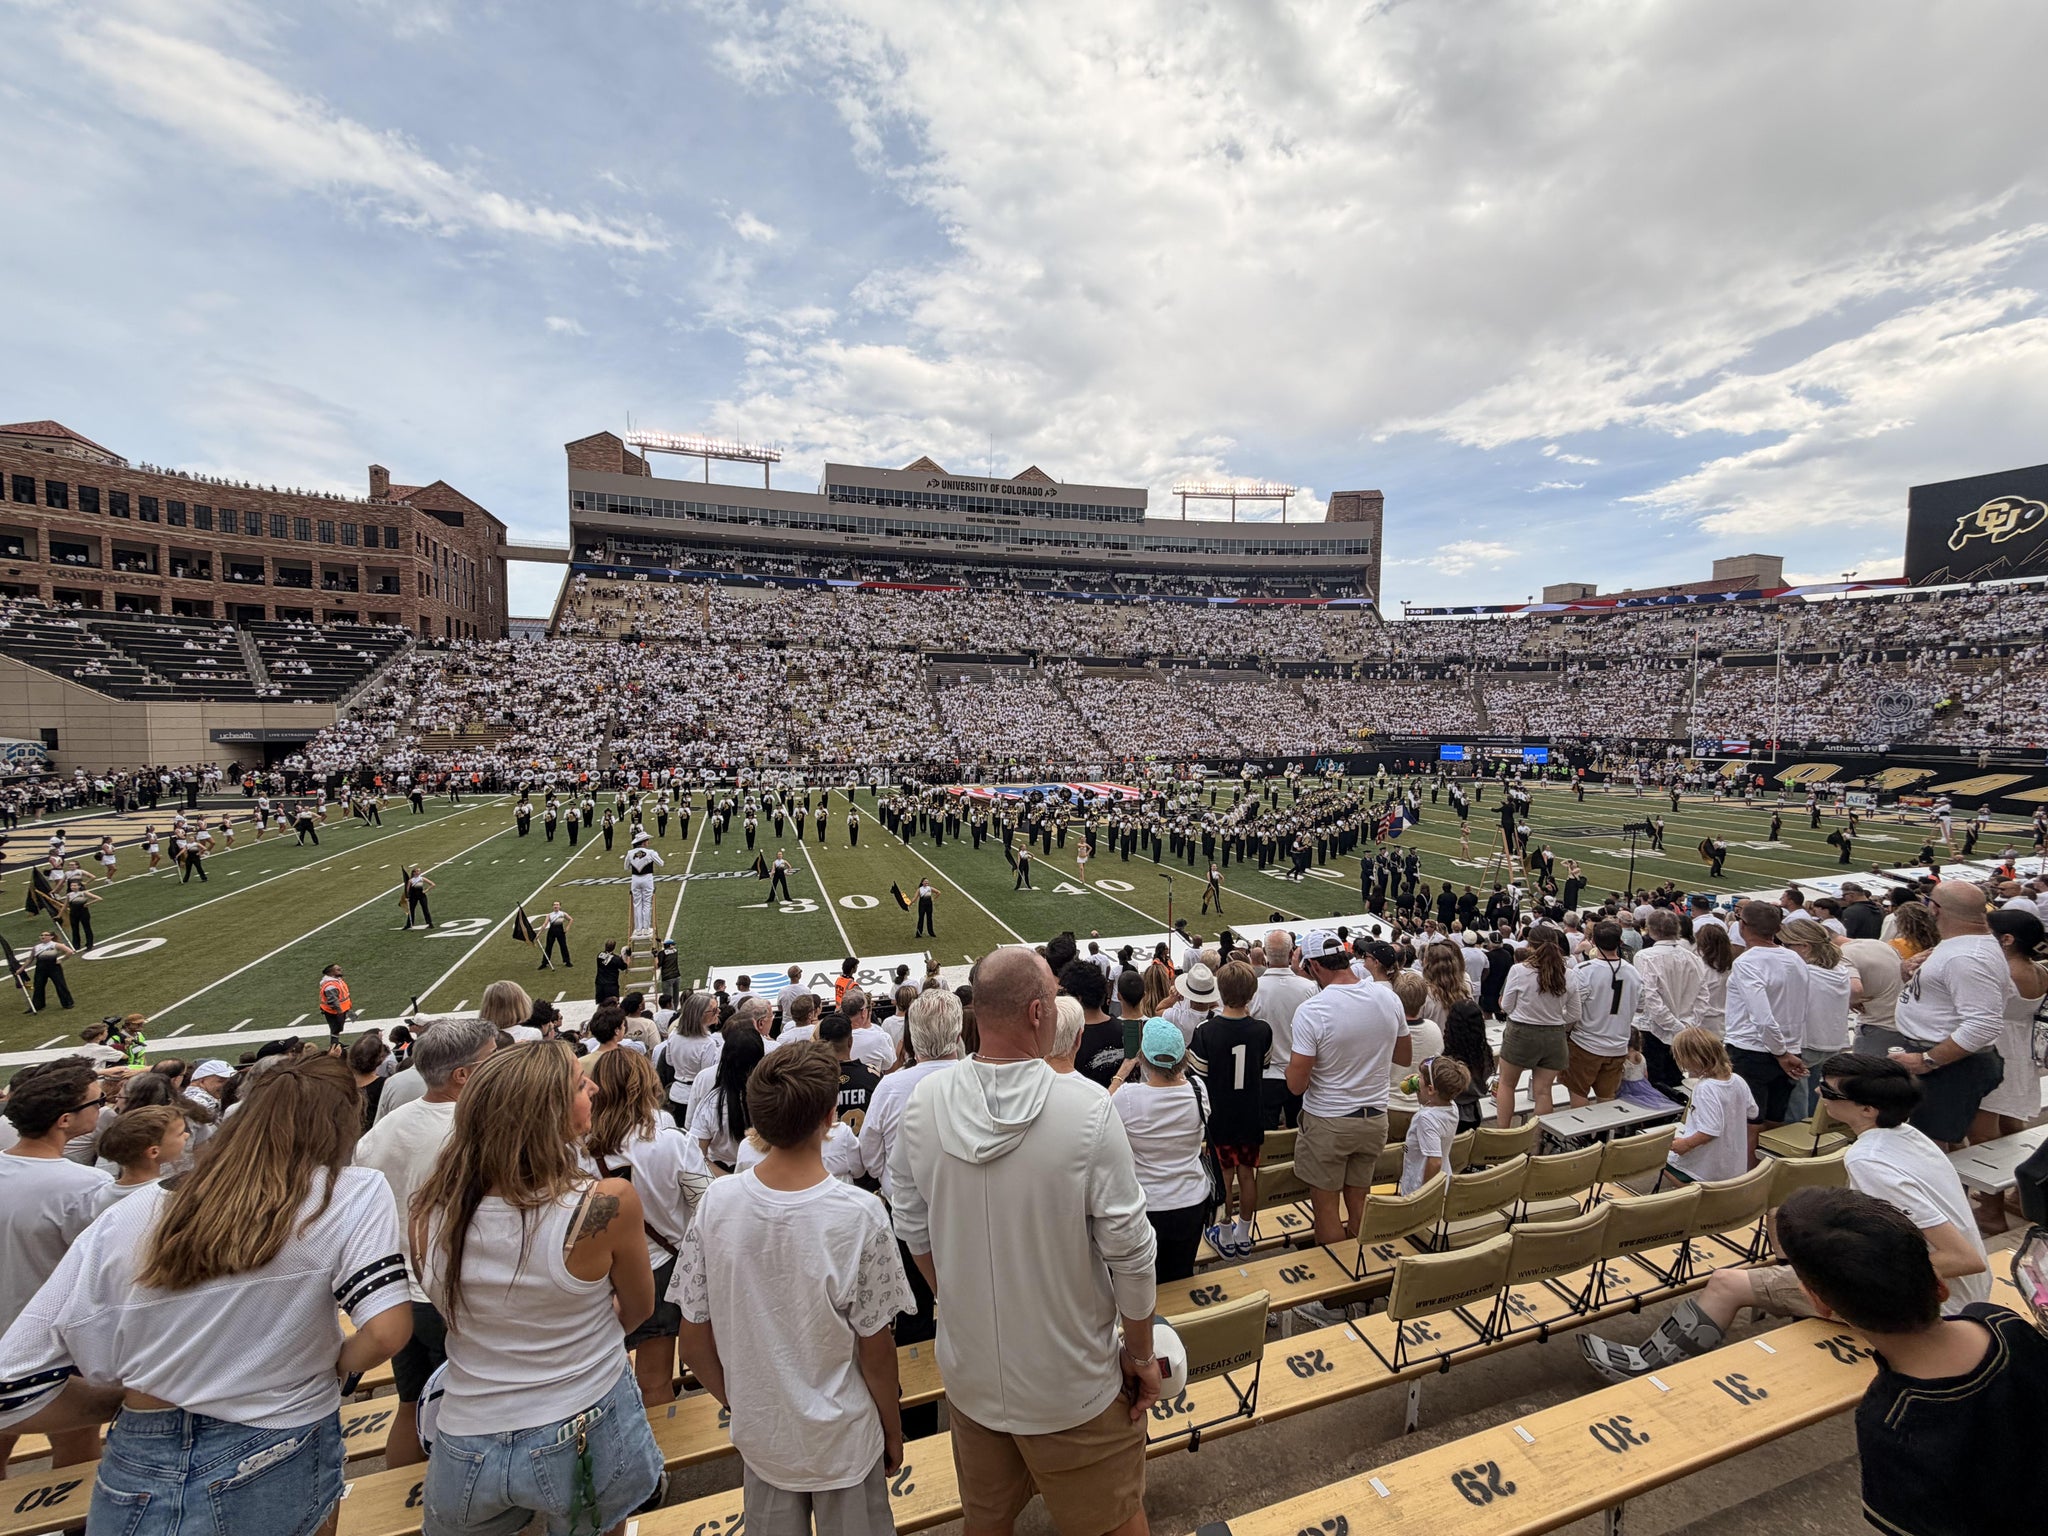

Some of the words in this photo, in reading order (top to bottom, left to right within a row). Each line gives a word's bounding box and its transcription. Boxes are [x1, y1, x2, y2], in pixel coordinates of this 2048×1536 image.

[941, 480, 987, 493] UNIVERSITY
[990, 484, 1000, 493] OF
[1002, 484, 1043, 497] COLORADO
[1975, 502, 2022, 533] CU
[47, 569, 127, 584] CRAWFORD
[633, 573, 648, 581] 220
[1893, 593, 1914, 604] 210
[1561, 616, 1577, 624] 212
[1823, 744, 1861, 752] Anthem
[1610, 979, 1624, 1015] 1
[1231, 1044, 1247, 1090] 1
[1189, 1284, 1229, 1307] 29
[1415, 1282, 1495, 1309] WWW.BUFFSEATS.COM
[1188, 1350, 1252, 1377] UFFSEATS.COM
[1285, 1348, 1335, 1379] 29
[1814, 1334, 1876, 1365] 32
[1712, 1372, 1769, 1406] 31
[341, 1409, 394, 1439] 22
[1589, 1414, 1651, 1454] 30
[891, 1464, 916, 1498] 2
[1451, 1460, 1517, 1507] 29
[13, 1478, 84, 1515] 20
